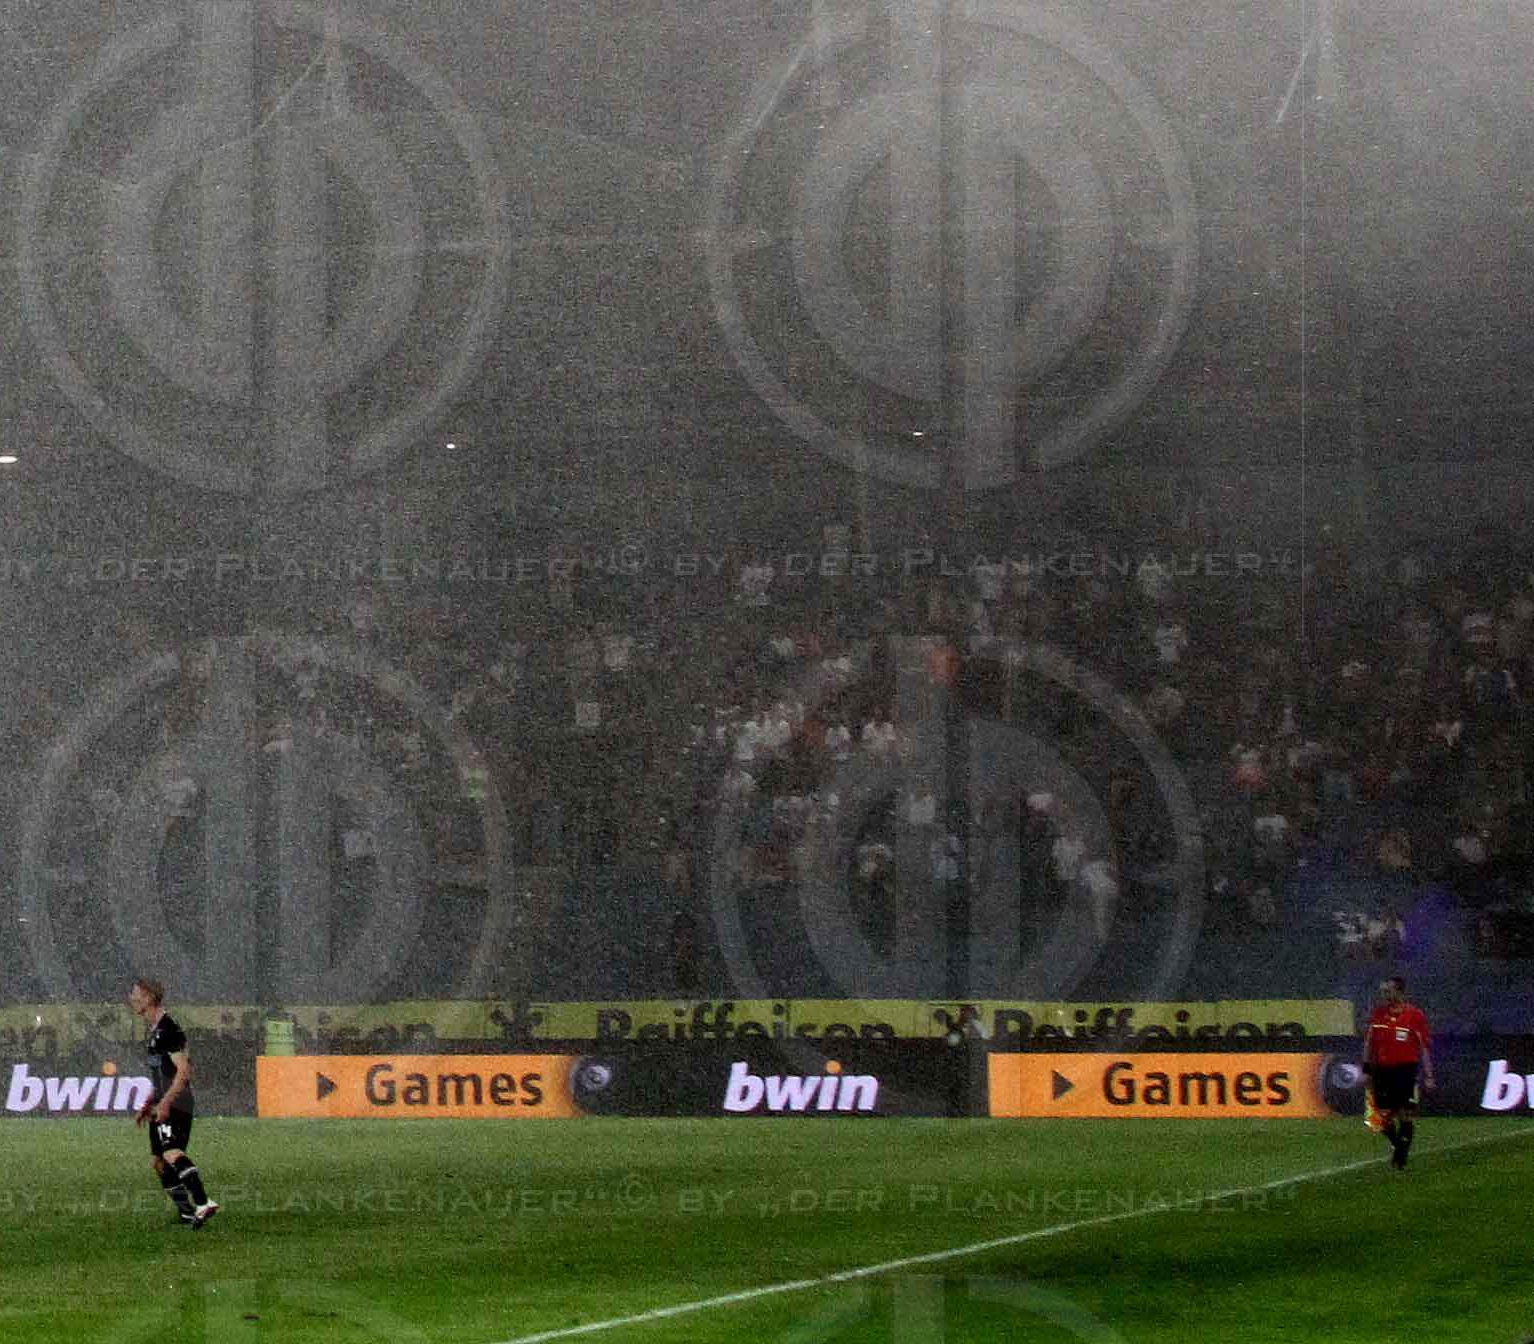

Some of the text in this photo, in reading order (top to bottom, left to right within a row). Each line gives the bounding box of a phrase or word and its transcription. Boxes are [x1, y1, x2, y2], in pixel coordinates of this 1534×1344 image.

[5, 1061, 153, 1112] bwin
[365, 1063, 544, 1107] Games
[723, 1061, 879, 1112] bwin
[1103, 1062, 1292, 1107] Games
